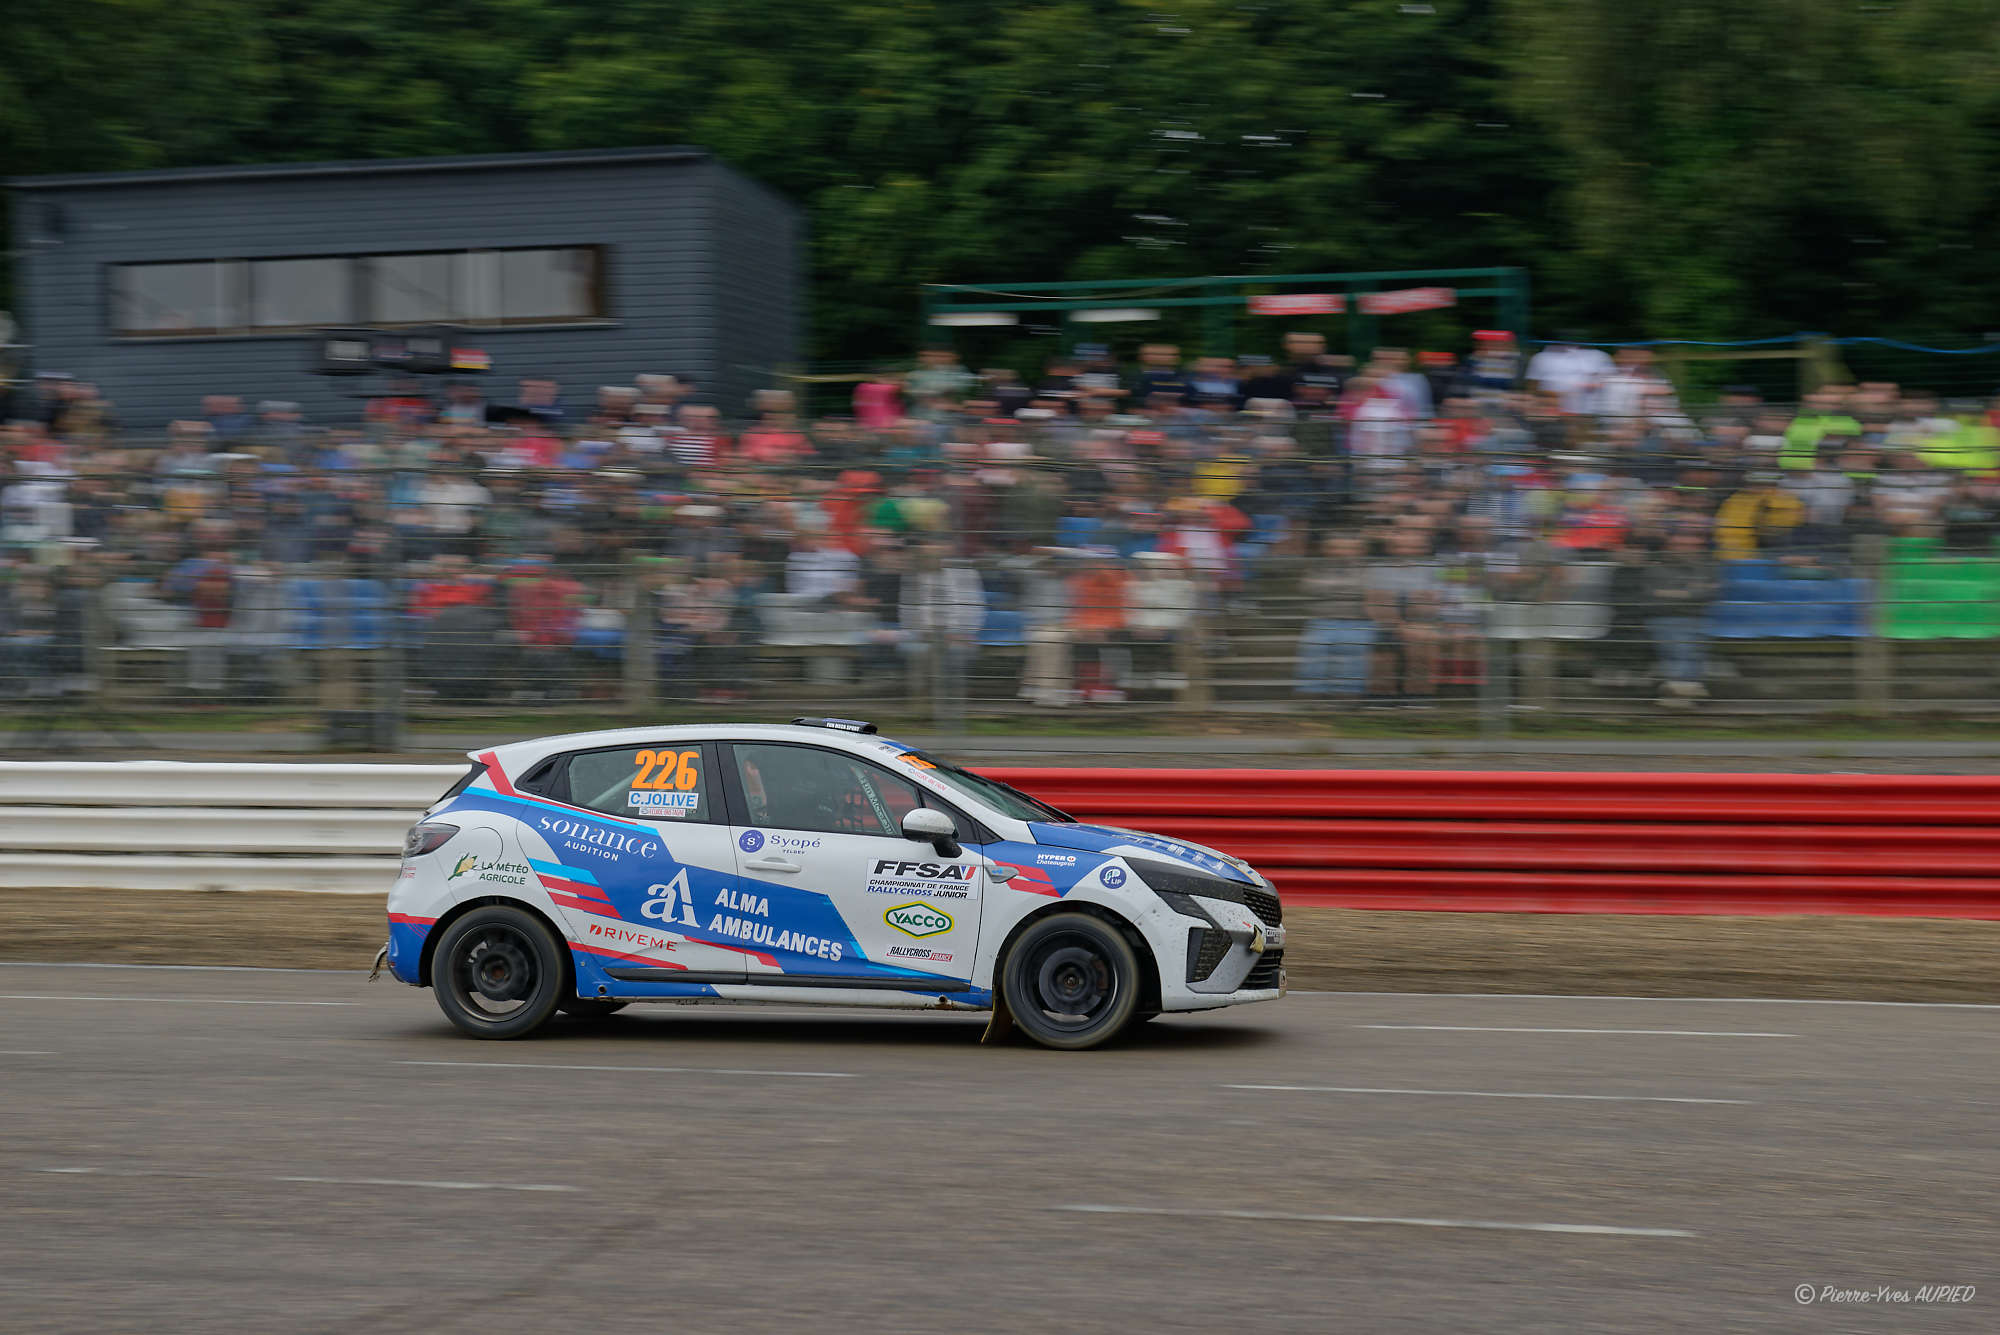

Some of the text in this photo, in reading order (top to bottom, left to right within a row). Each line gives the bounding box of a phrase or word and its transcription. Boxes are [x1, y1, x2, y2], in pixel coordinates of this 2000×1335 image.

[632, 750, 699, 790] 226
[631, 793, 696, 807] C.JOLIVE
[538, 816, 657, 858] sonance
[770, 835, 820, 848] Syopé
[564, 840, 619, 861] AUDITION
[481, 861, 529, 874] LA MÉTÉO
[874, 860, 963, 880] FFSA
[479, 873, 526, 885] AGRICOLE
[869, 879, 925, 888] CHAMPIONNAT
[867, 886, 968, 899] RALLYCROSS JUNIOR
[715, 888, 769, 917] ALMA
[893, 912, 946, 929] YACCO
[708, 913, 843, 962] AMBULANCES
[890, 946, 932, 958] RALLYCROSS
